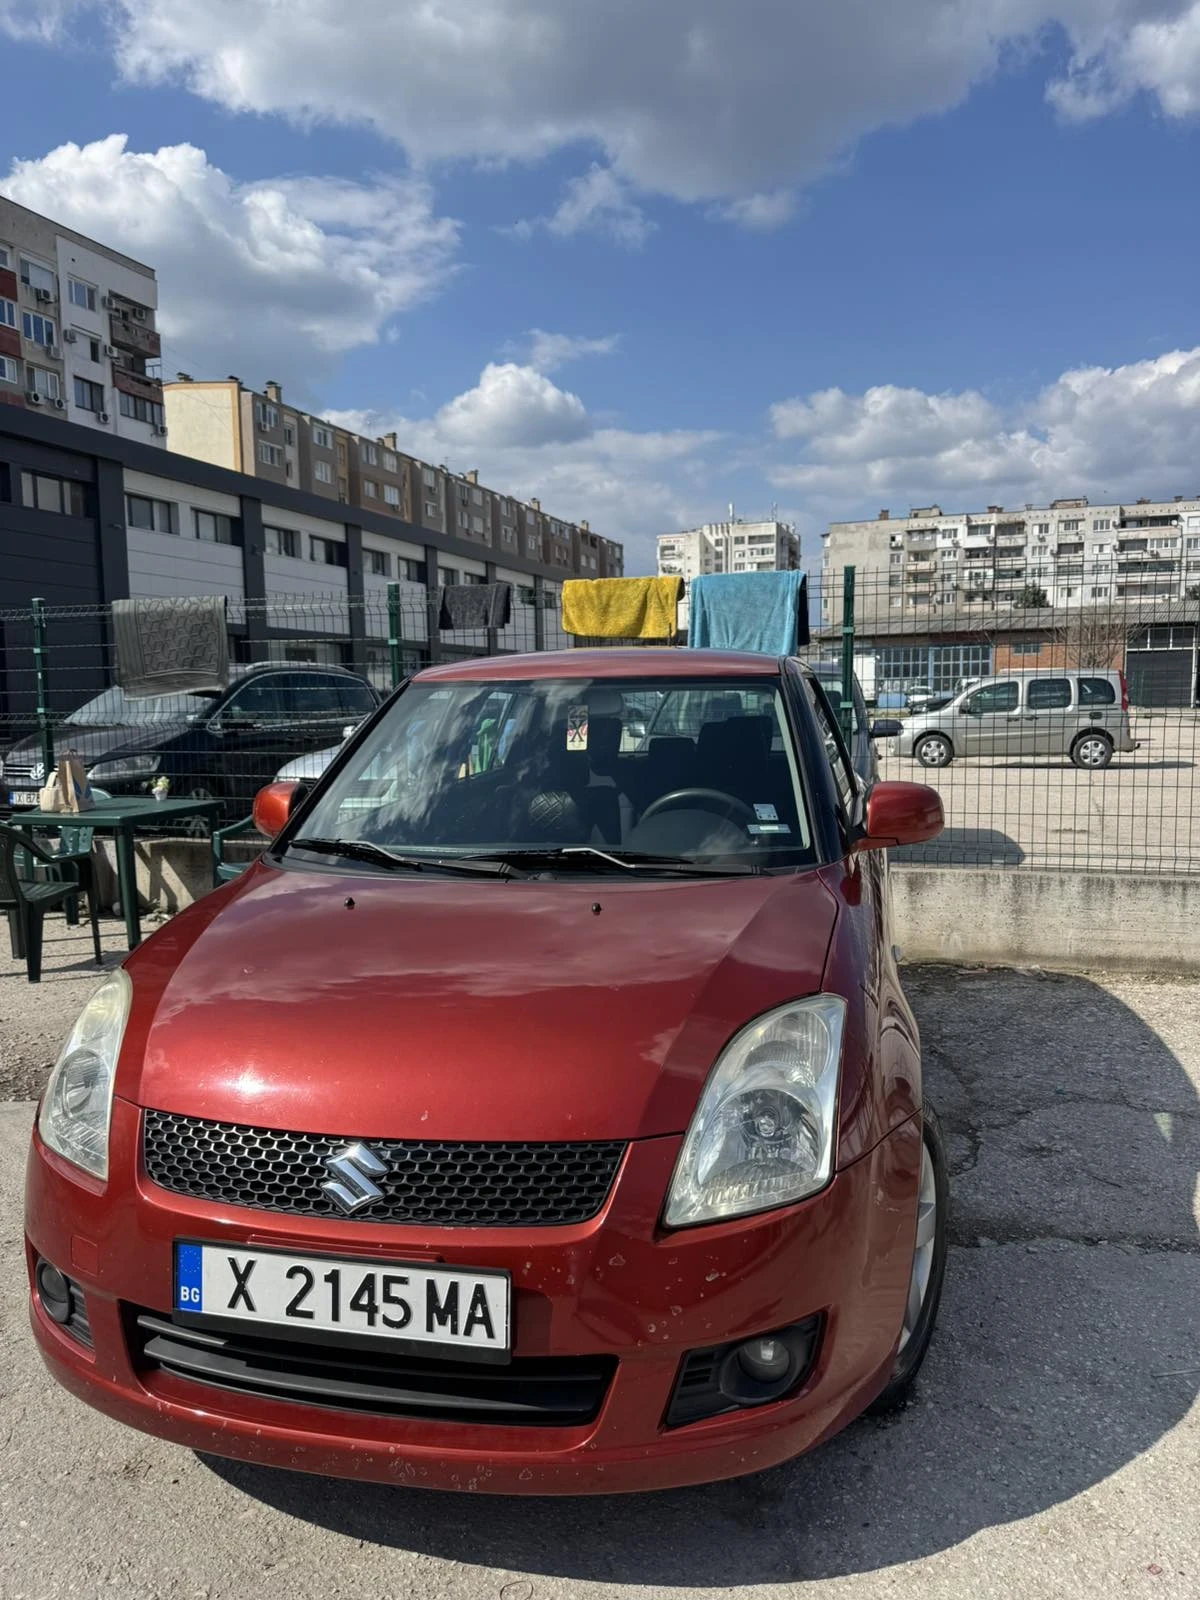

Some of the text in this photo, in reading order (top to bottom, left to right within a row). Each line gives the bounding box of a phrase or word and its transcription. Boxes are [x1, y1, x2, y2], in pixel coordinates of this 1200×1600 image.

[180, 1285, 200, 1303] BG
[227, 1256, 496, 1340] X 2145 MA
